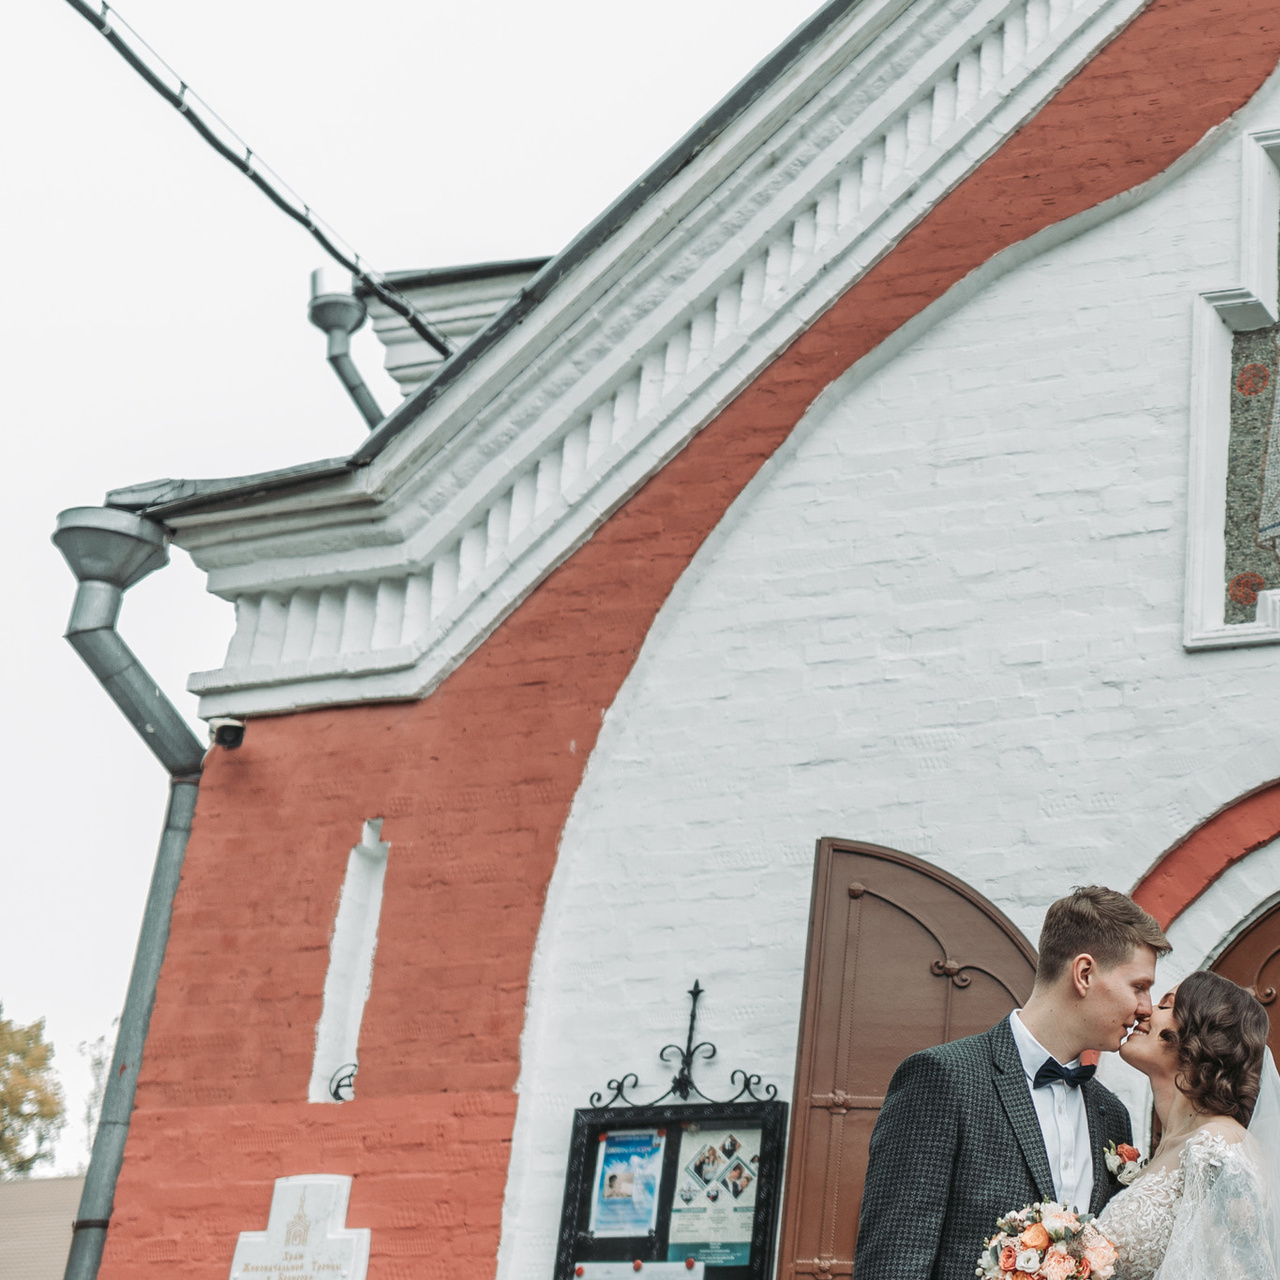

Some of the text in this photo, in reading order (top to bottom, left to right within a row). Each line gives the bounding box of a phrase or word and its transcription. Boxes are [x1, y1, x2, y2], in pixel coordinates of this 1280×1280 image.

[282, 1251, 304, 1262] Храм
[242, 1261, 342, 1273] Живоначальной Троицы
